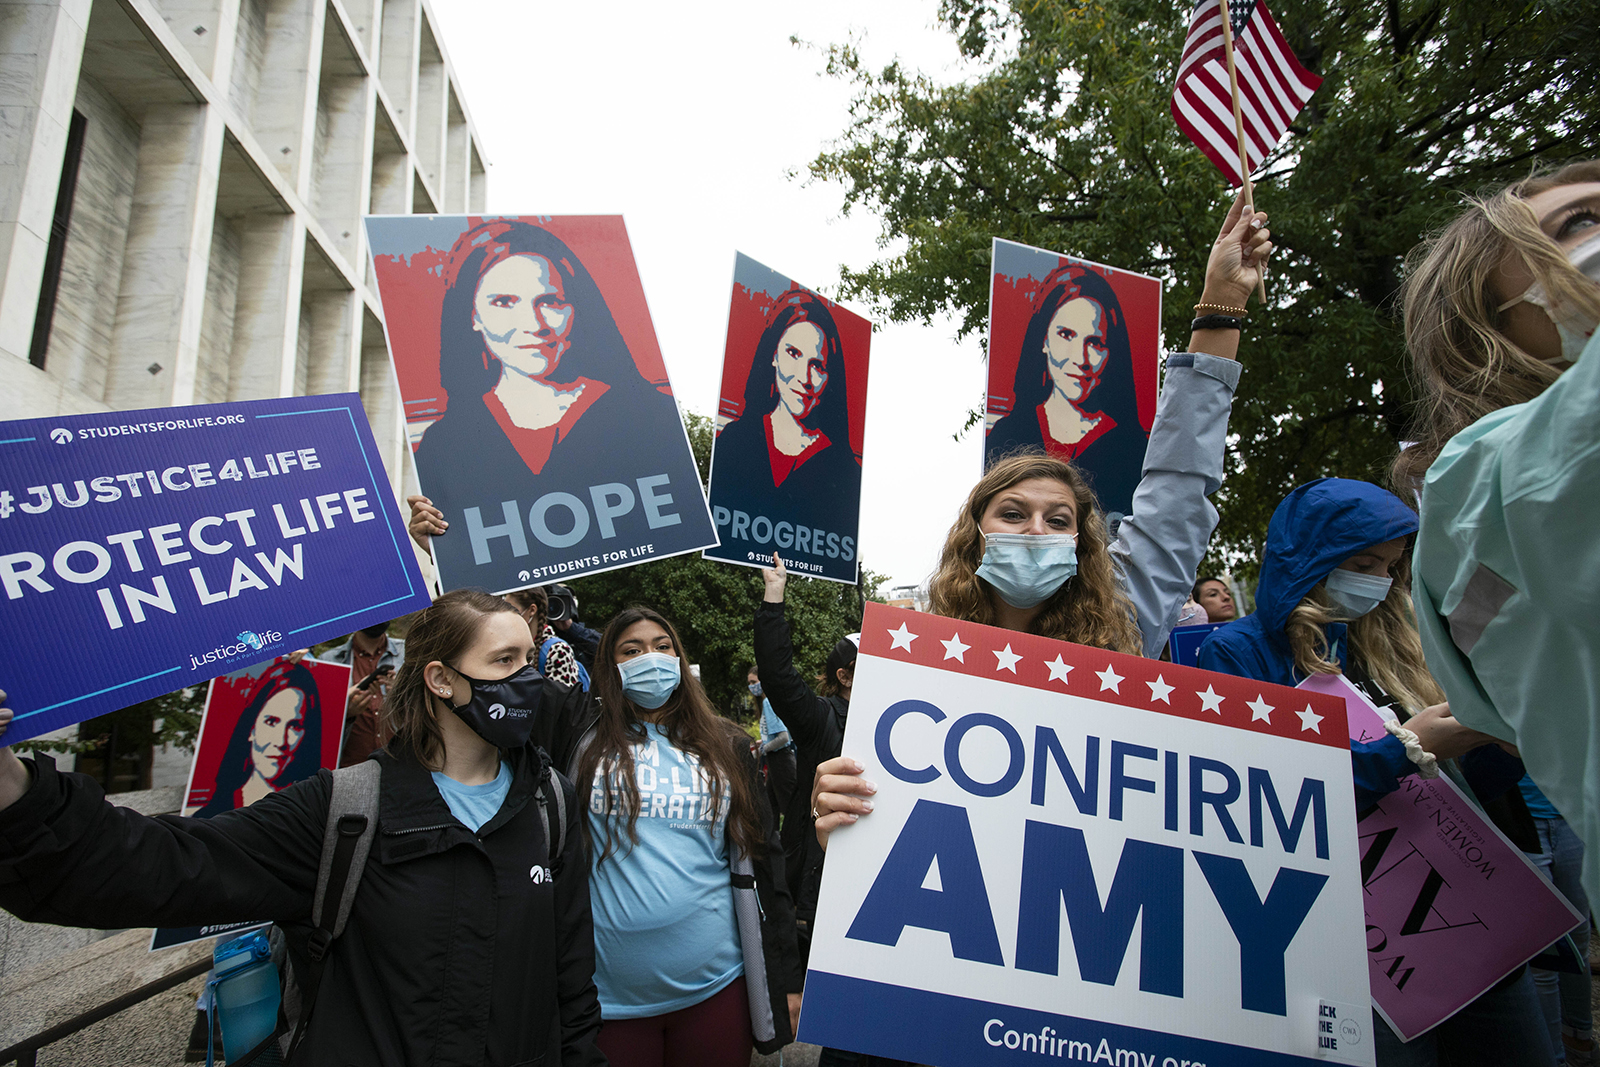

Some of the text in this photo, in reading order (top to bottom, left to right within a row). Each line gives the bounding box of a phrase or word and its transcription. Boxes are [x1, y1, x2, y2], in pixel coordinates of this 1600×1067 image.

[78, 414, 246, 439] STUDENTSFORLIFE.ORG
[0, 447, 322, 519] #JUSTICE4LIFE
[0, 487, 376, 600] ROTECT LIFE
[463, 473, 682, 566] HOPE
[713, 504, 855, 562] PROGRESS
[97, 543, 304, 630] IN LAW
[532, 544, 655, 578] STUDENTS FOR LIFE
[755, 553, 824, 573] STUDNTS FOR LIFE
[241, 652, 255, 660] Part
[263, 642, 285, 652] History
[873, 699, 1330, 861] CONFIRM
[1423, 780, 1486, 845] LEGISLATIVE ACTION
[1357, 803, 1490, 937] AM
[1428, 808, 1496, 881] WOMEN
[1436, 831, 1471, 869] CONCERNED
[844, 798, 1330, 1017] AMY
[1364, 911, 1416, 994] WO
[1318, 1004, 1337, 1019] ACK
